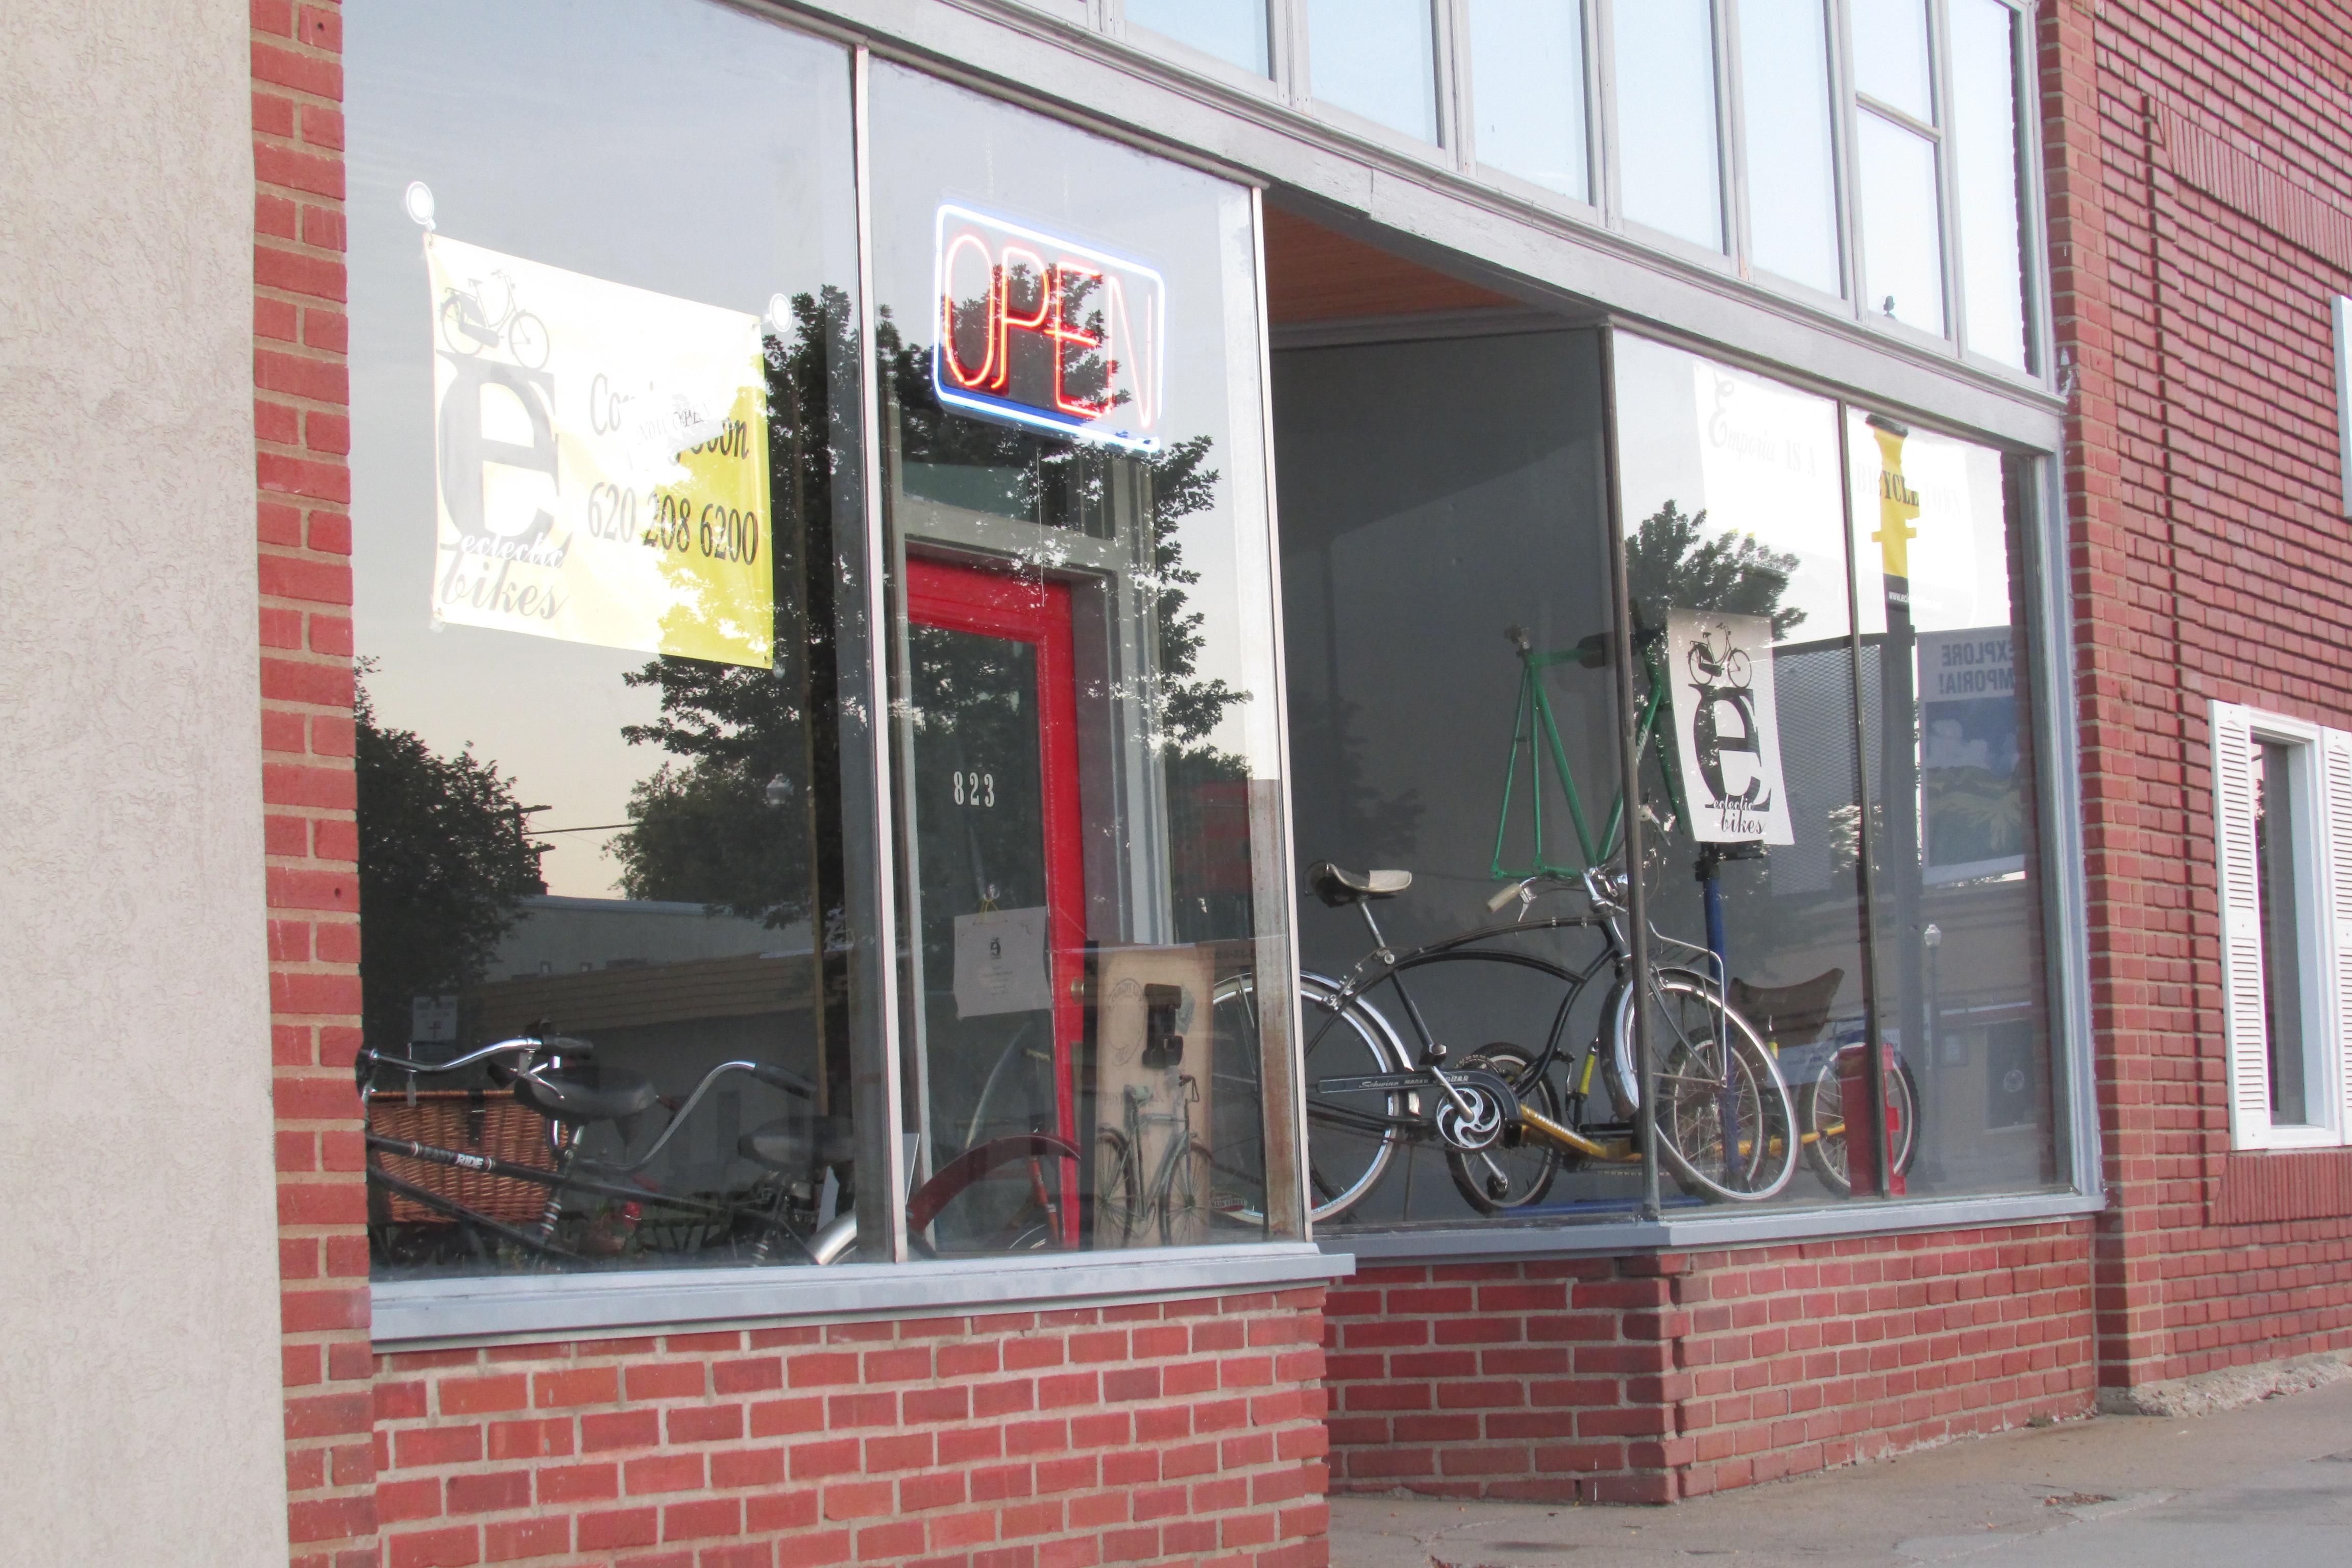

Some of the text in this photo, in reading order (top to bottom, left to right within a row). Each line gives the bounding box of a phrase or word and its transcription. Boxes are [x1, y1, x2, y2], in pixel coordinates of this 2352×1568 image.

[944, 233, 1153, 428] OPEN
[1708, 370, 1776, 463] Emporia
[1785, 438, 1801, 472] IS
[1806, 445, 1818, 477] A
[1856, 462, 1919, 507] BICYCLE
[588, 482, 758, 566] 620 208 6200
[460, 531, 565, 569] eclectic
[439, 550, 570, 620] bikes
[953, 771, 995, 807] 823
[1713, 794, 1755, 811] eclectic
[1721, 809, 1766, 834] bikes
[454, 1153, 484, 1169] RIDE
